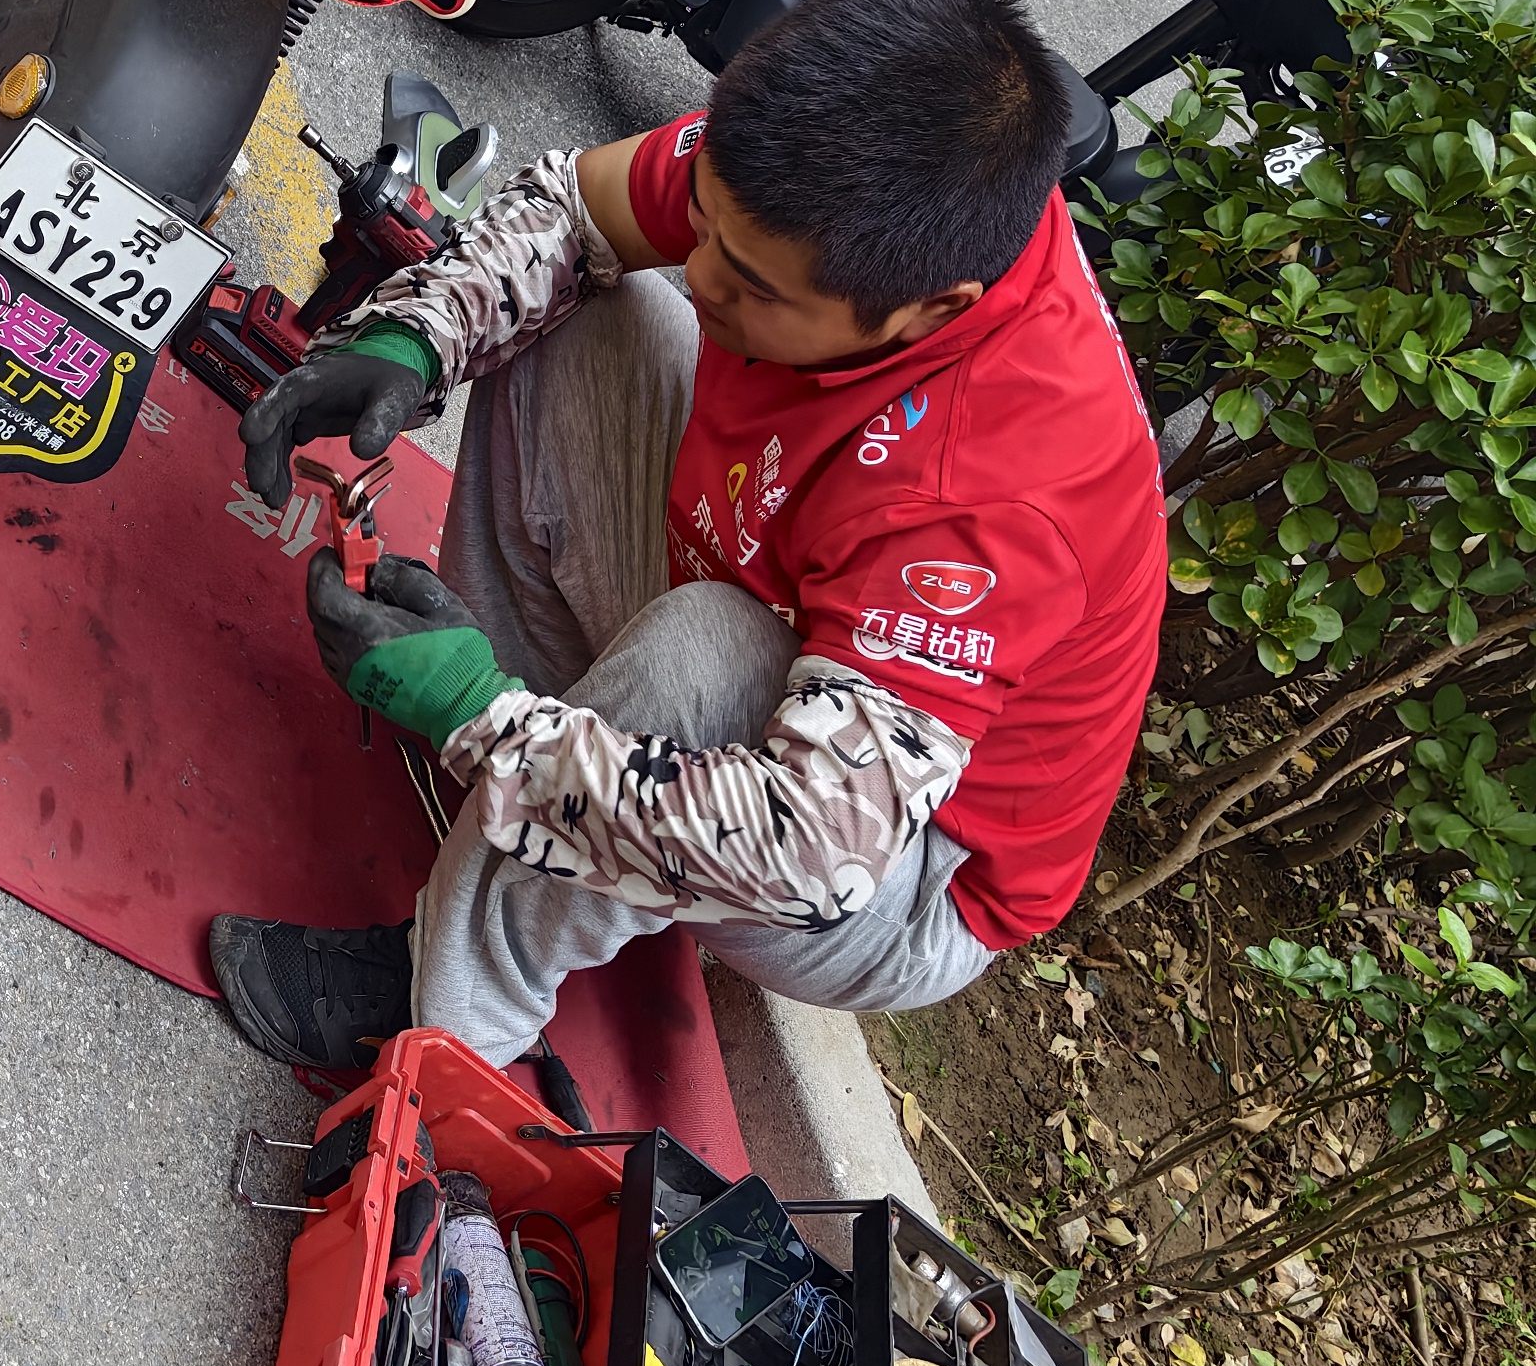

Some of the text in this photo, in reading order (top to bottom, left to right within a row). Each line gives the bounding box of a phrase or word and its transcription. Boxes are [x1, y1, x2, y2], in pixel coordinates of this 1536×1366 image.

[56, 179, 171, 265] 北京
[921, 572, 971, 595] ZUB
[855, 606, 996, 666] 五星钻豹
